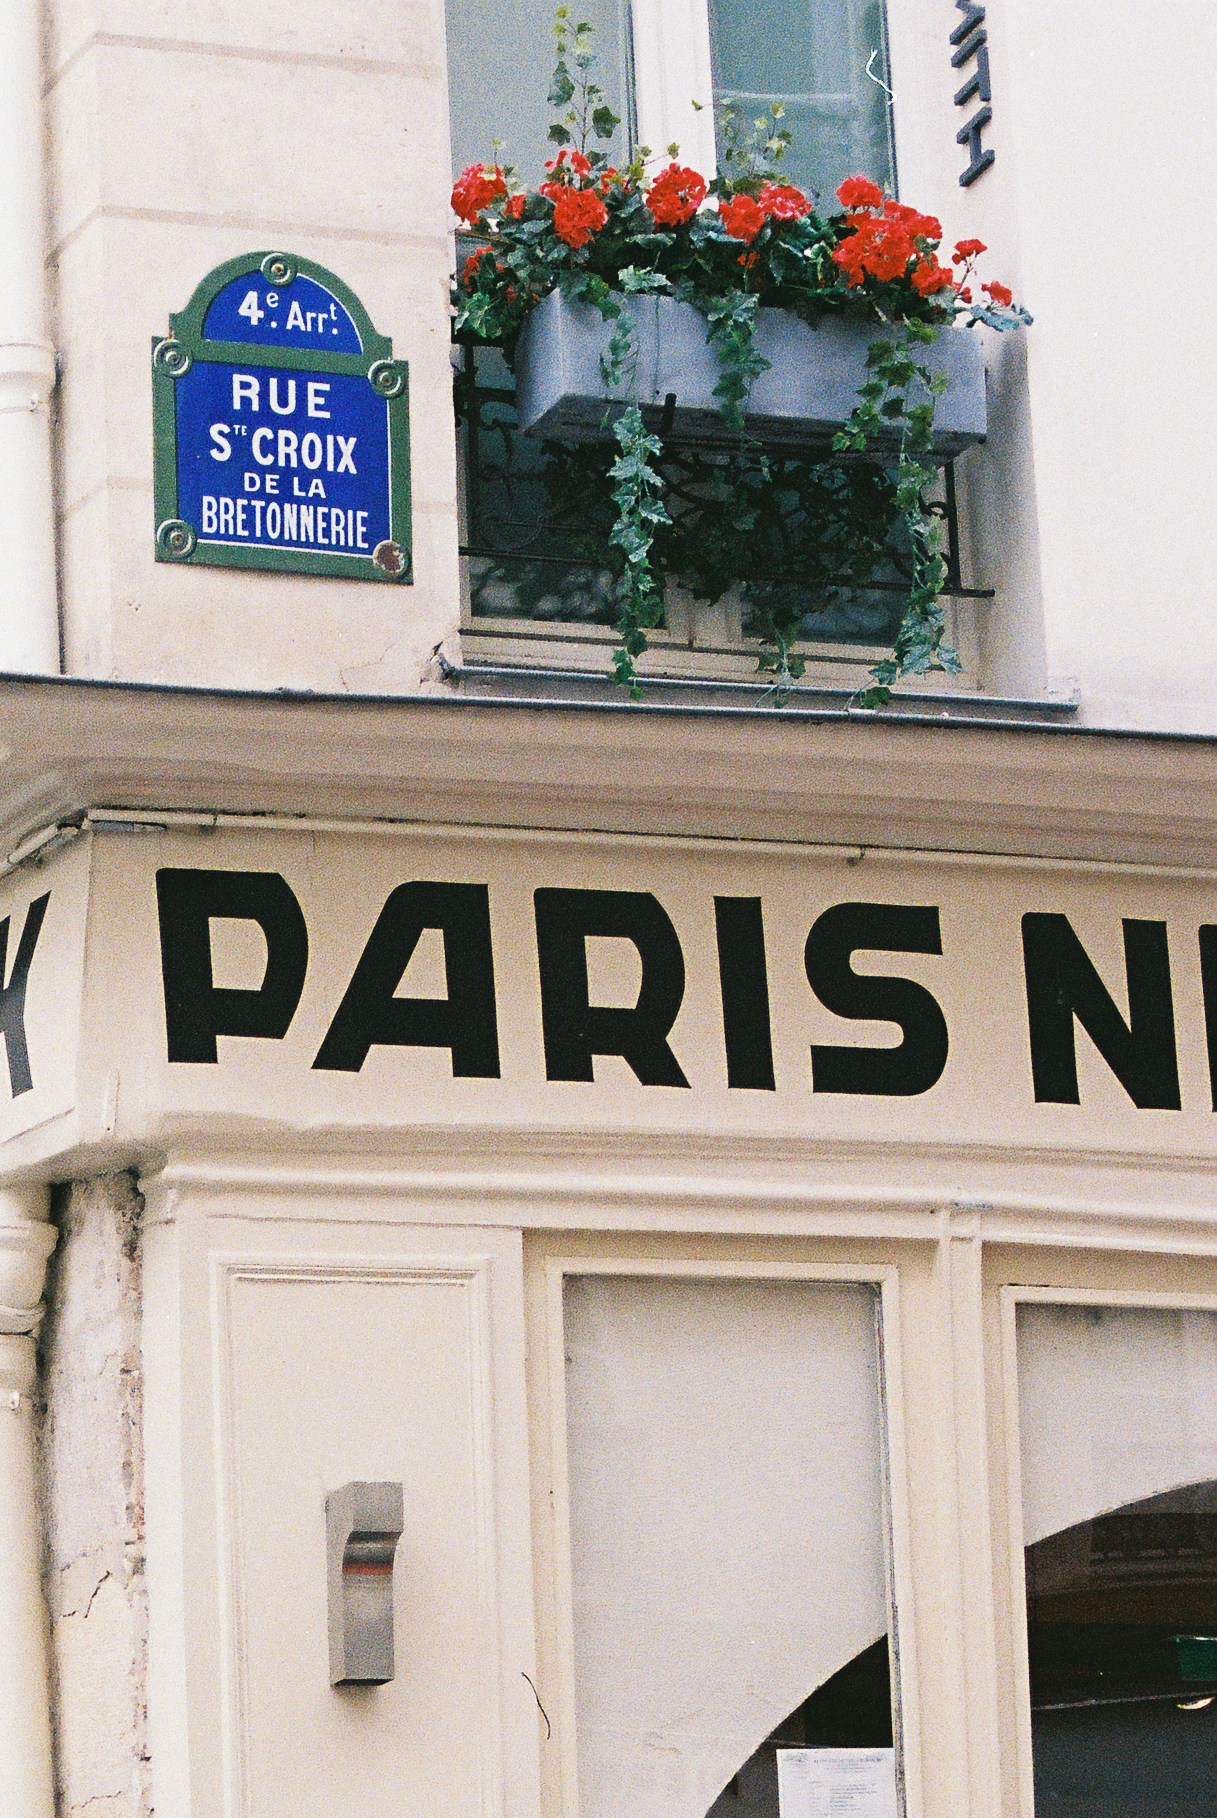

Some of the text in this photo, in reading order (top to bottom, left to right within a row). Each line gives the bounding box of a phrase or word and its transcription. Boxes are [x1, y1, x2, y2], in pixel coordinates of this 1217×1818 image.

[232, 373, 331, 419] RUE
[251, 426, 357, 475] CROIX
[244, 472, 326, 499] DE LA
[202, 495, 370, 549] BRETONNERIE
[155, 867, 1217, 1113] PARIS N
